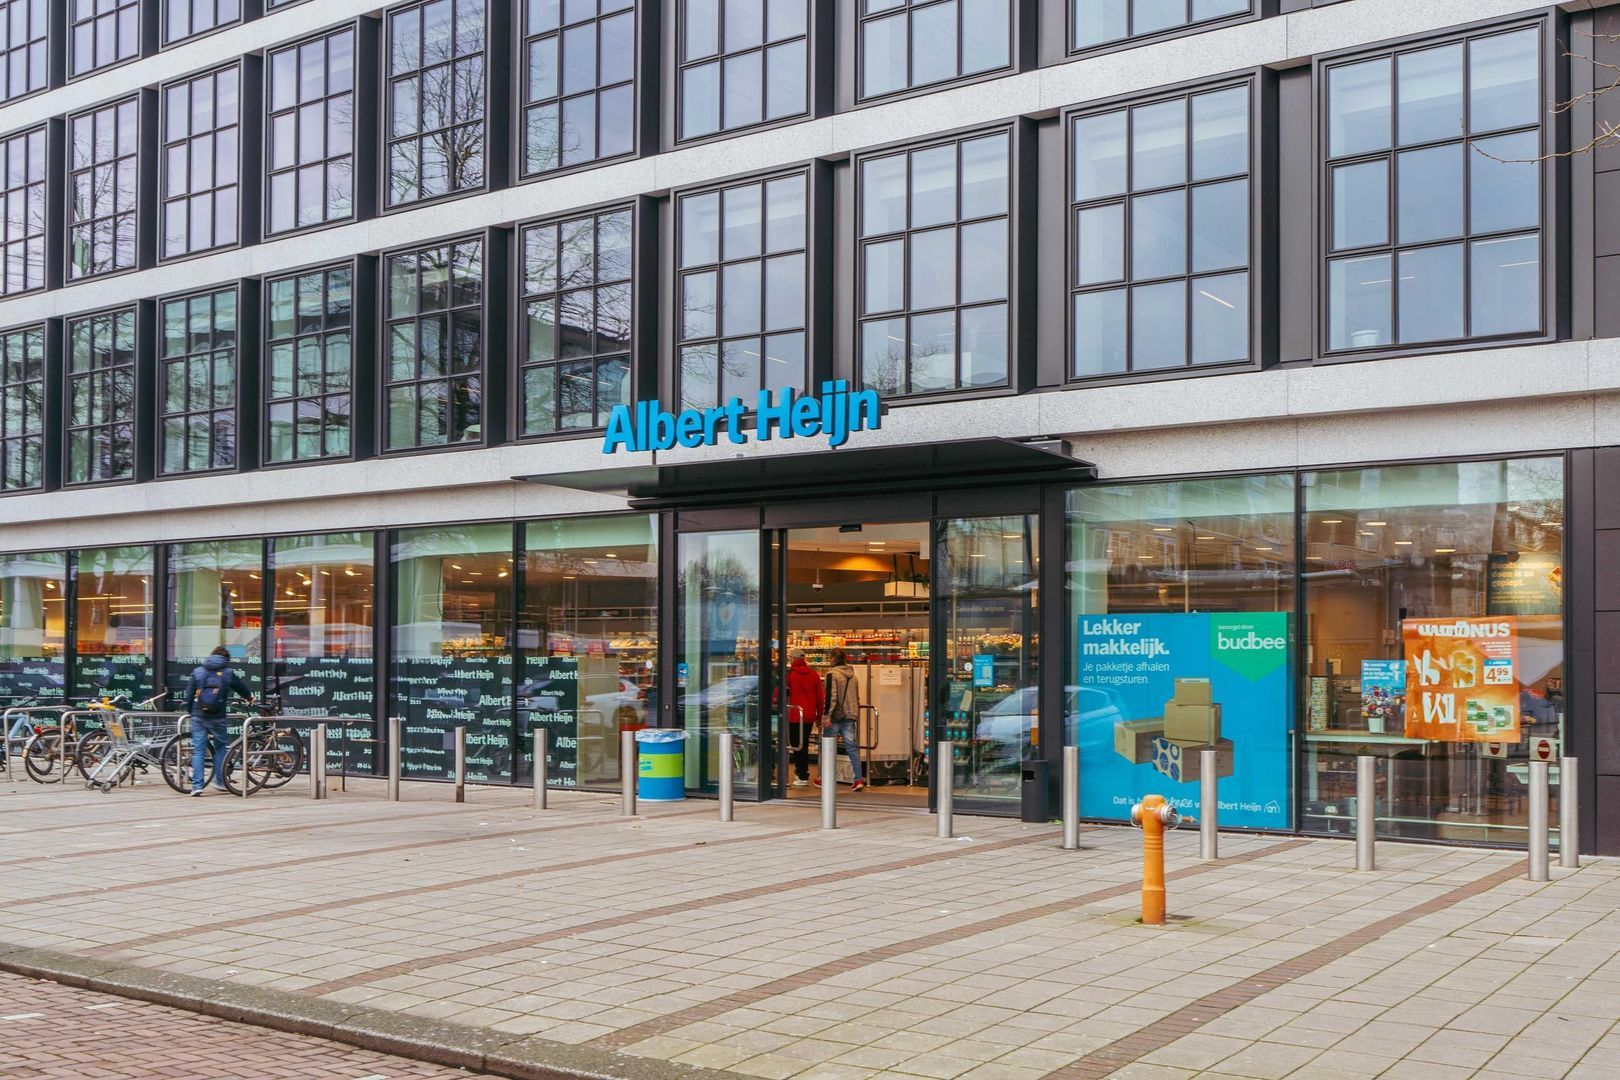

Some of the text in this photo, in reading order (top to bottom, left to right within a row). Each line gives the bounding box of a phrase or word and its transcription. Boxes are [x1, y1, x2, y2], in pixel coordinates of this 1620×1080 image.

[602, 379, 881, 454] Albert Heijn
[1083, 619, 1142, 635] Lekker
[1083, 638, 1170, 659] makkelijk.
[1218, 632, 1286, 650] budbee
[1083, 661, 1170, 673] Je pakketje afhalen
[1083, 676, 1094, 684] en
[529, 711, 574, 724] Albert Heijn
[466, 733, 508, 748] lbert Heijn
[1113, 796, 1127, 805] Dat
[1128, 796, 1135, 805] is
[1218, 800, 1238, 810] lbert
[1240, 802, 1261, 812] Heijn
